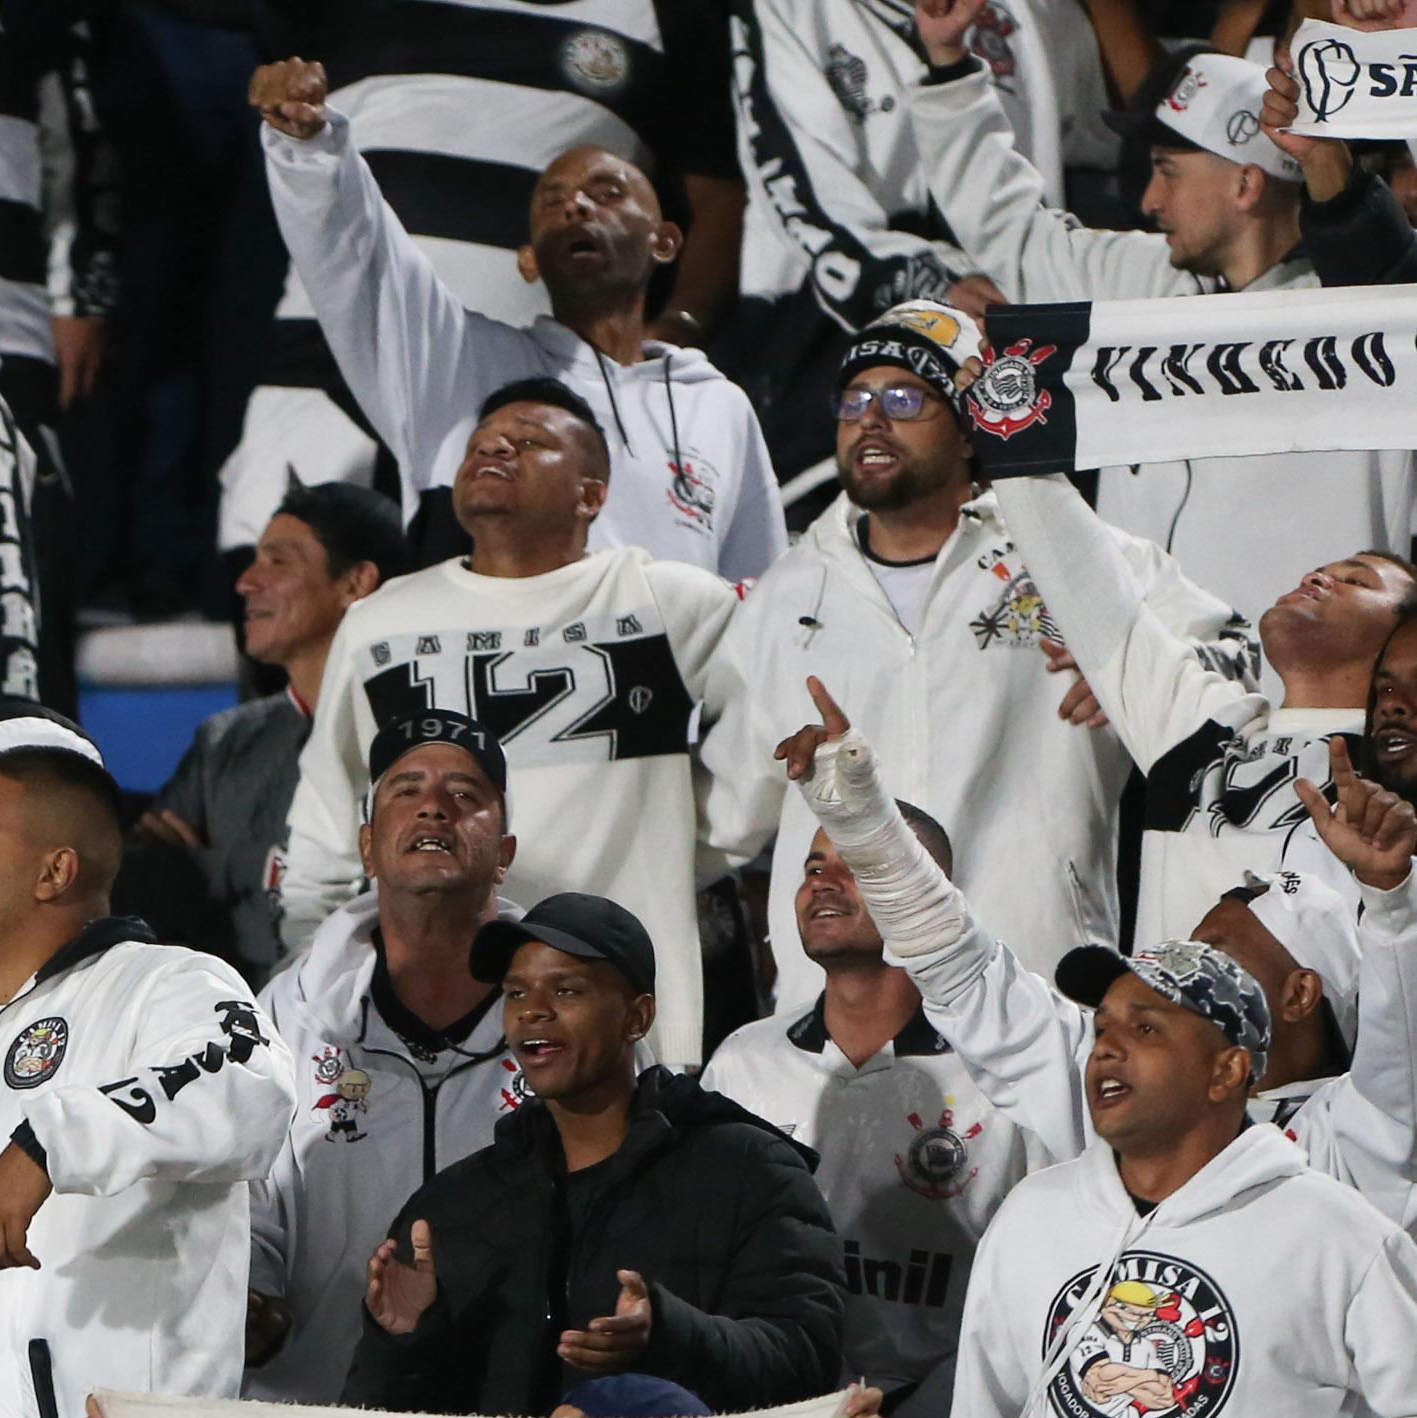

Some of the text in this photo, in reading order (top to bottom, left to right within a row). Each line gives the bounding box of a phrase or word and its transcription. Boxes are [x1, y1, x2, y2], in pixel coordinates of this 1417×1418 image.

[842, 340, 905, 368] ISA
[370, 615, 644, 666] CAMISA
[398, 718, 485, 750] 1971
[1066, 1259, 1229, 1343] CMISA 12
